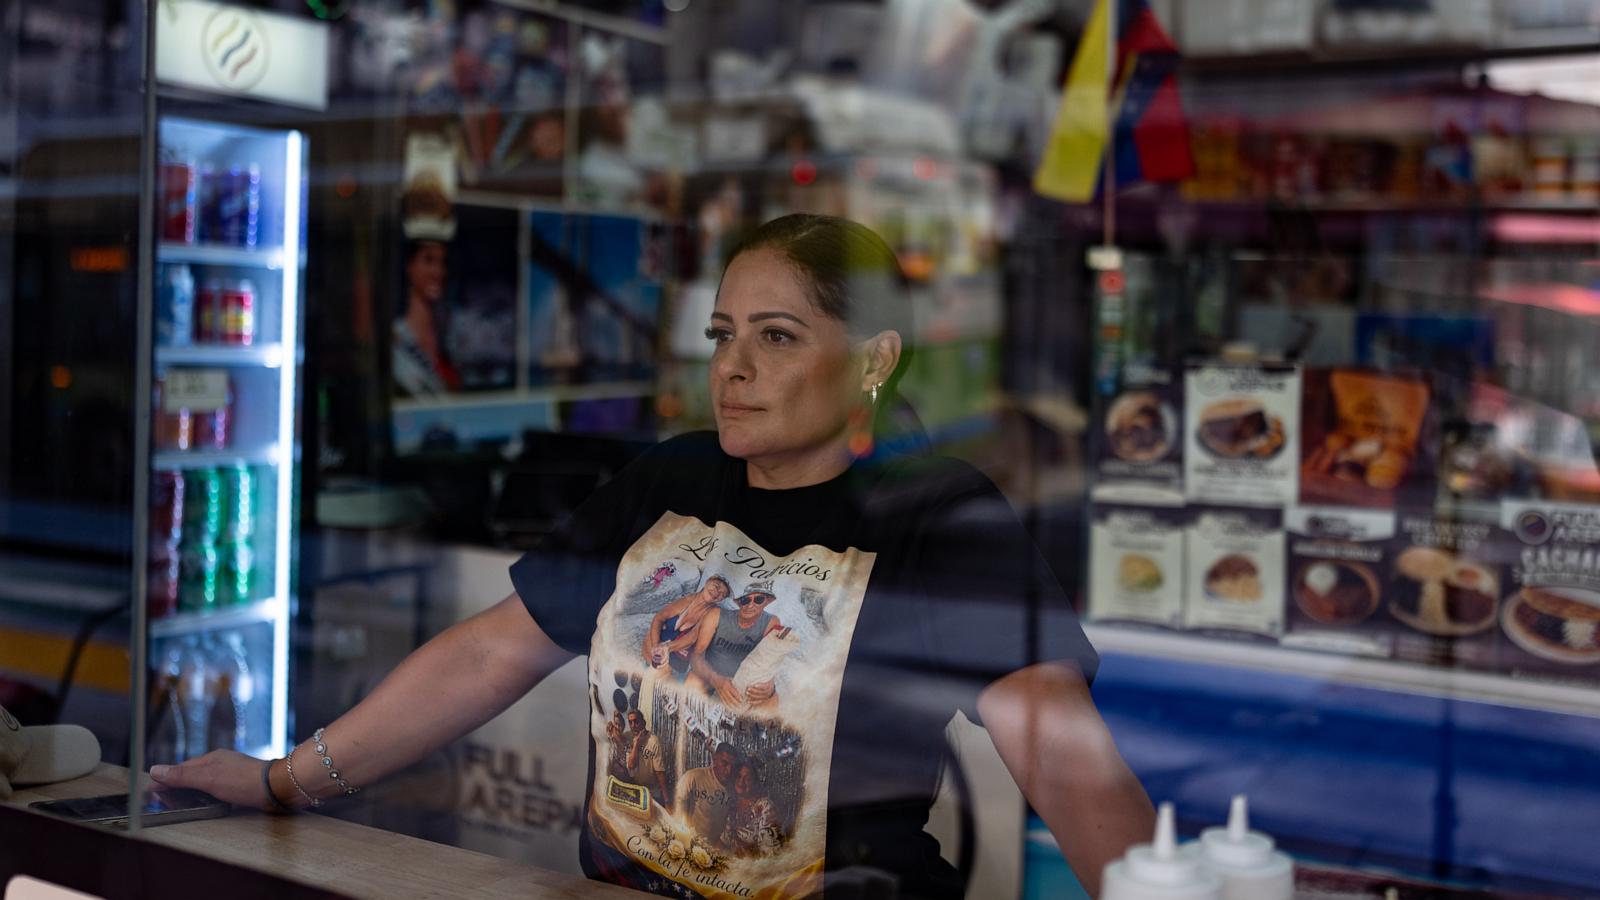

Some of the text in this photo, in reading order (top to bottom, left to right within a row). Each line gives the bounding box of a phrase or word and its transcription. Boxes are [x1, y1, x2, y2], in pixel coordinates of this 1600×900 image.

[463, 744, 555, 791] FULL
[626, 835, 755, 898] Con la fe intacta.
